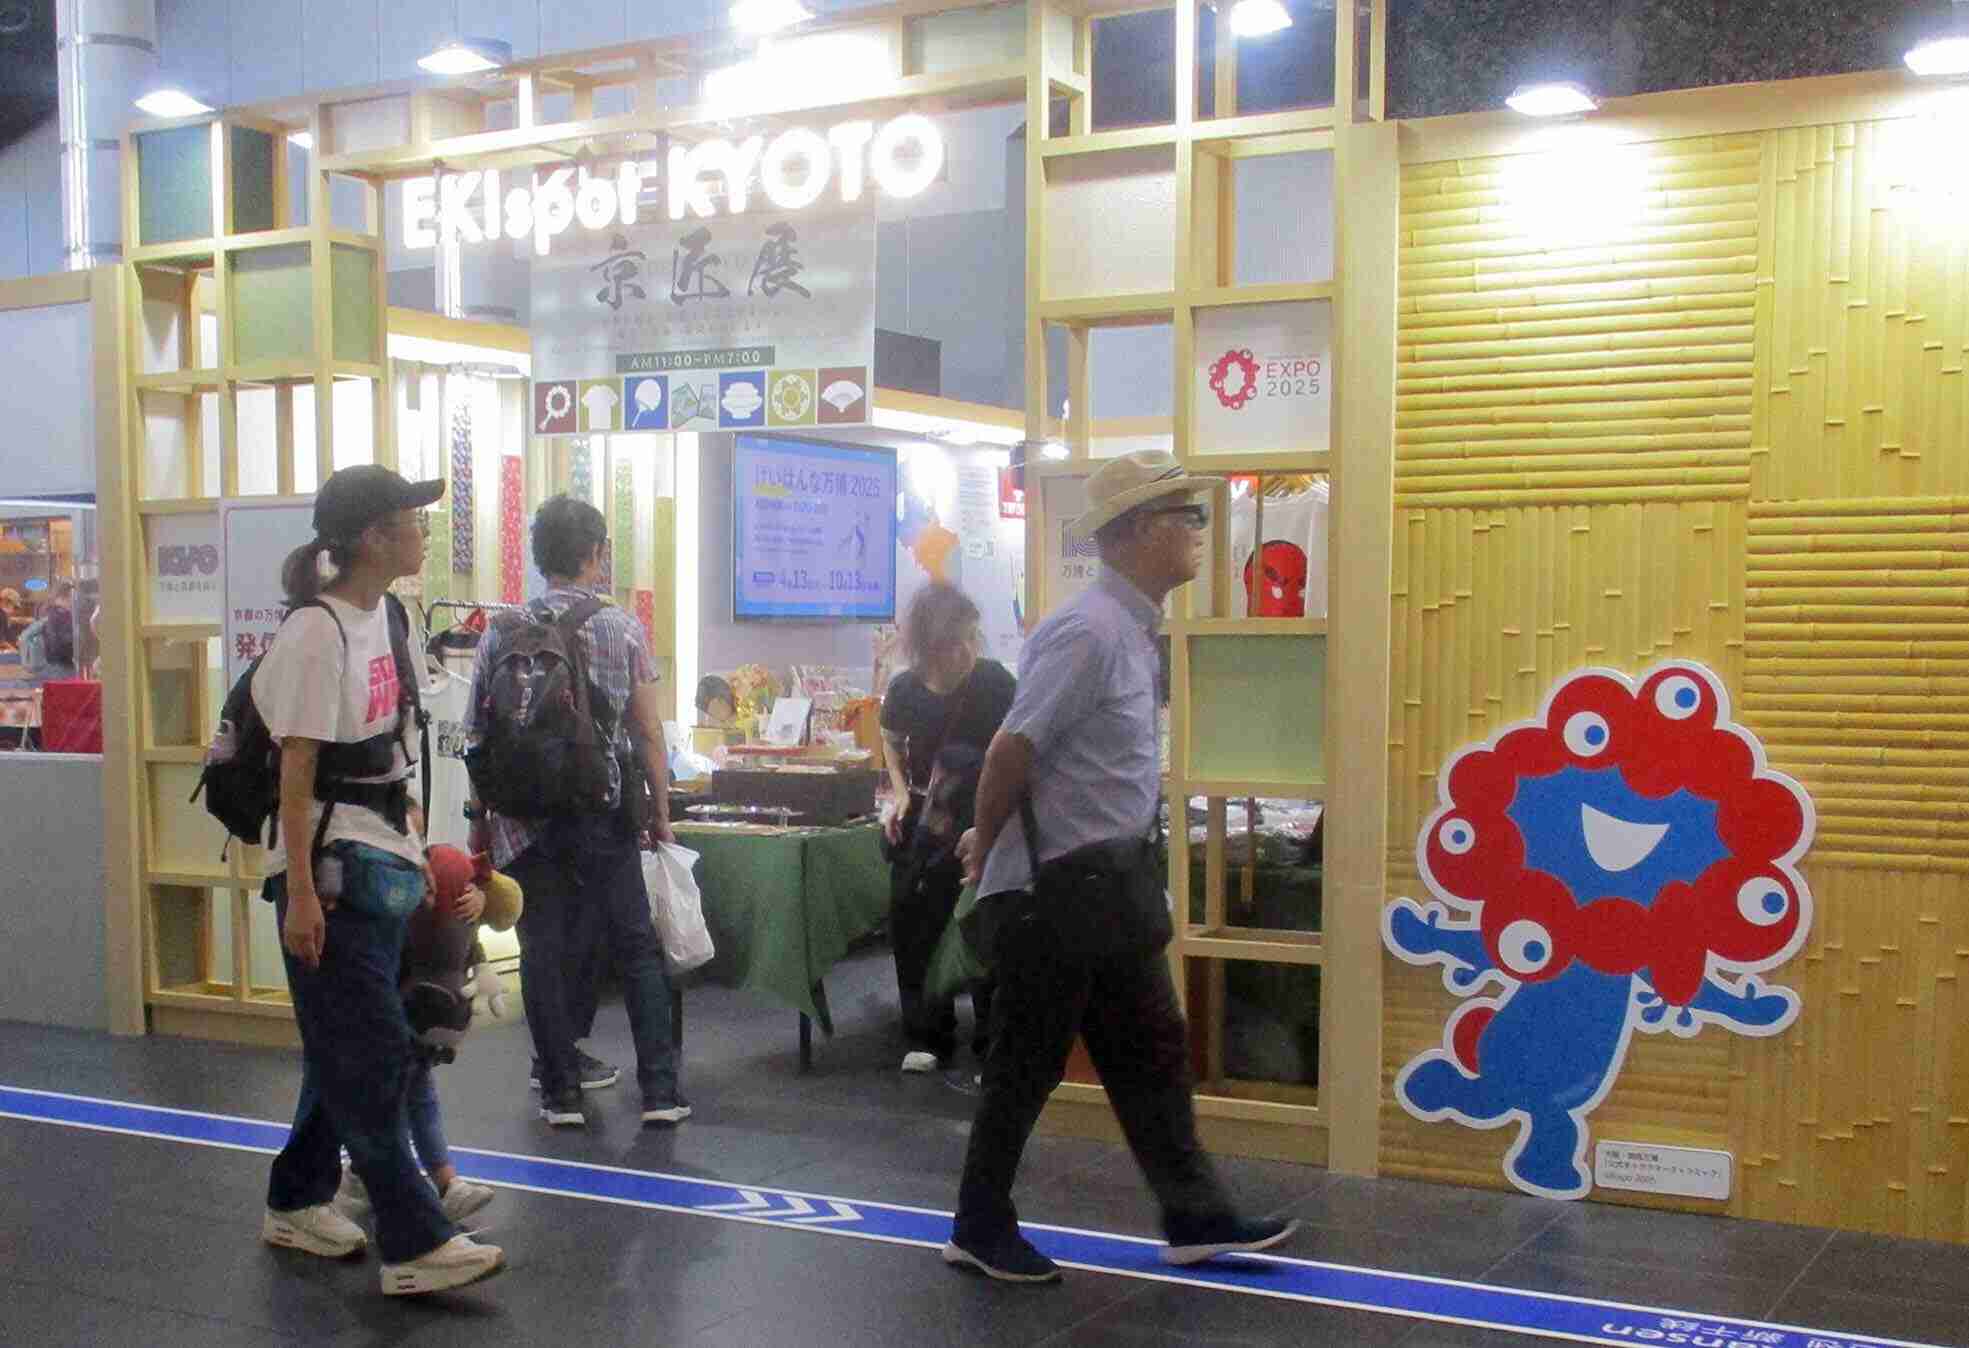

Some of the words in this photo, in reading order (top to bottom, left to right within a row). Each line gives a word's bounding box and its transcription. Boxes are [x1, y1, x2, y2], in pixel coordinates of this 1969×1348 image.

[668, 113, 944, 220] KYOTO
[591, 221, 812, 310] 京匠展
[1266, 359, 1321, 378] EXPO
[1266, 378, 1320, 397] 2025
